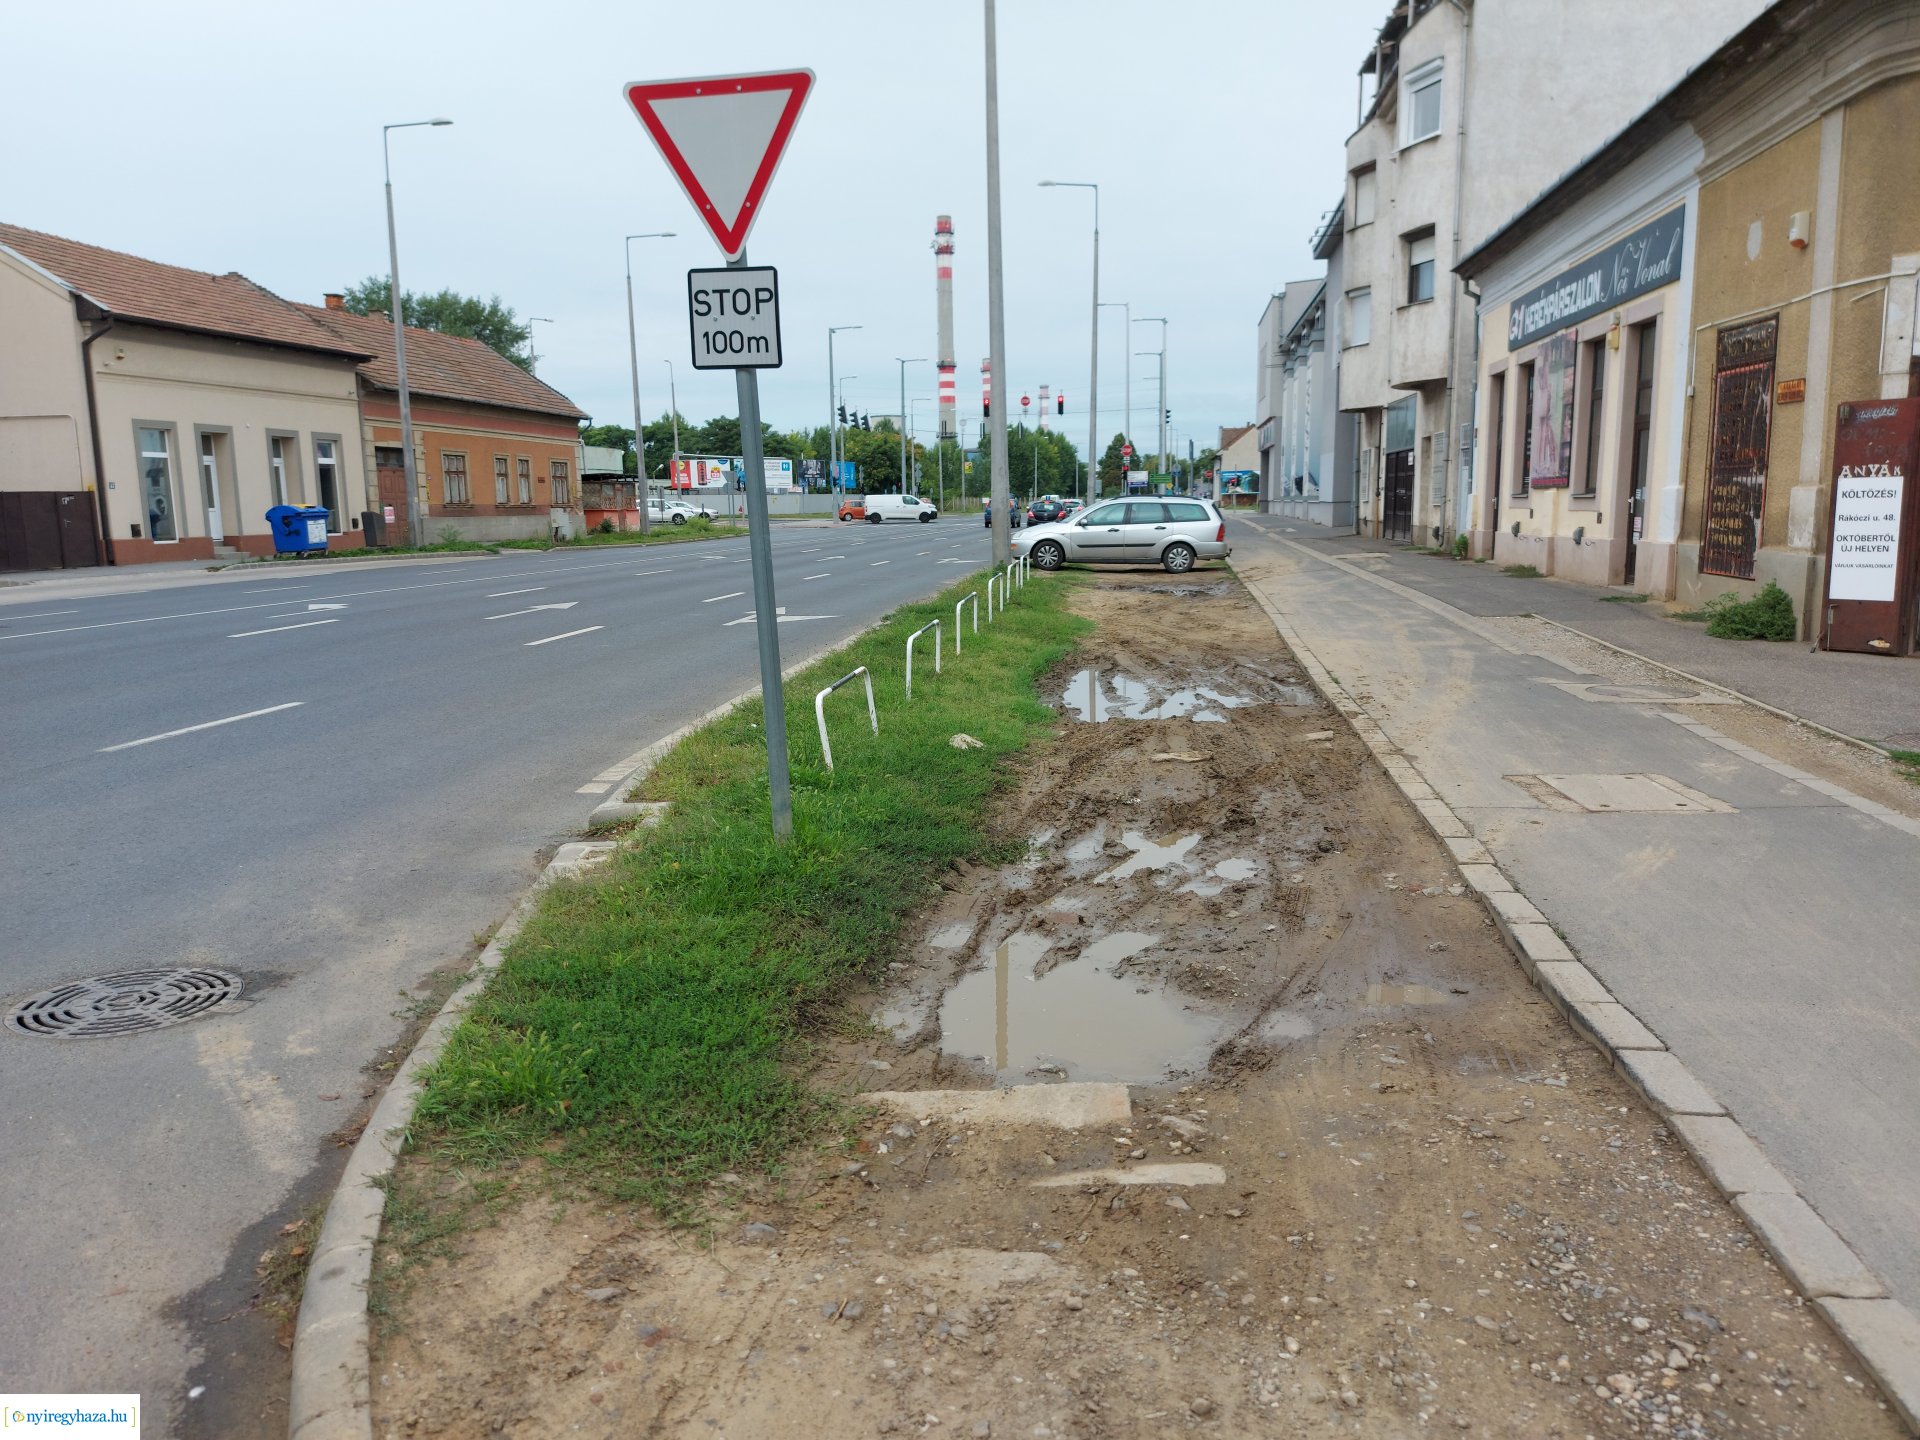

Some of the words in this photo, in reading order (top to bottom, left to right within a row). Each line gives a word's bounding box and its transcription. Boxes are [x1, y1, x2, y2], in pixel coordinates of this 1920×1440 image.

[1524, 269, 1602, 336] KERÉKPÁRSZALON
[1631, 226, 1681, 289] Vonal
[693, 288, 774, 317] STOP
[702, 330, 770, 354] 100m
[1841, 488, 1897, 499] KÖLTÖZÉS!
[1838, 513, 1871, 522] Rákóczi
[1883, 513, 1896, 521] 48.
